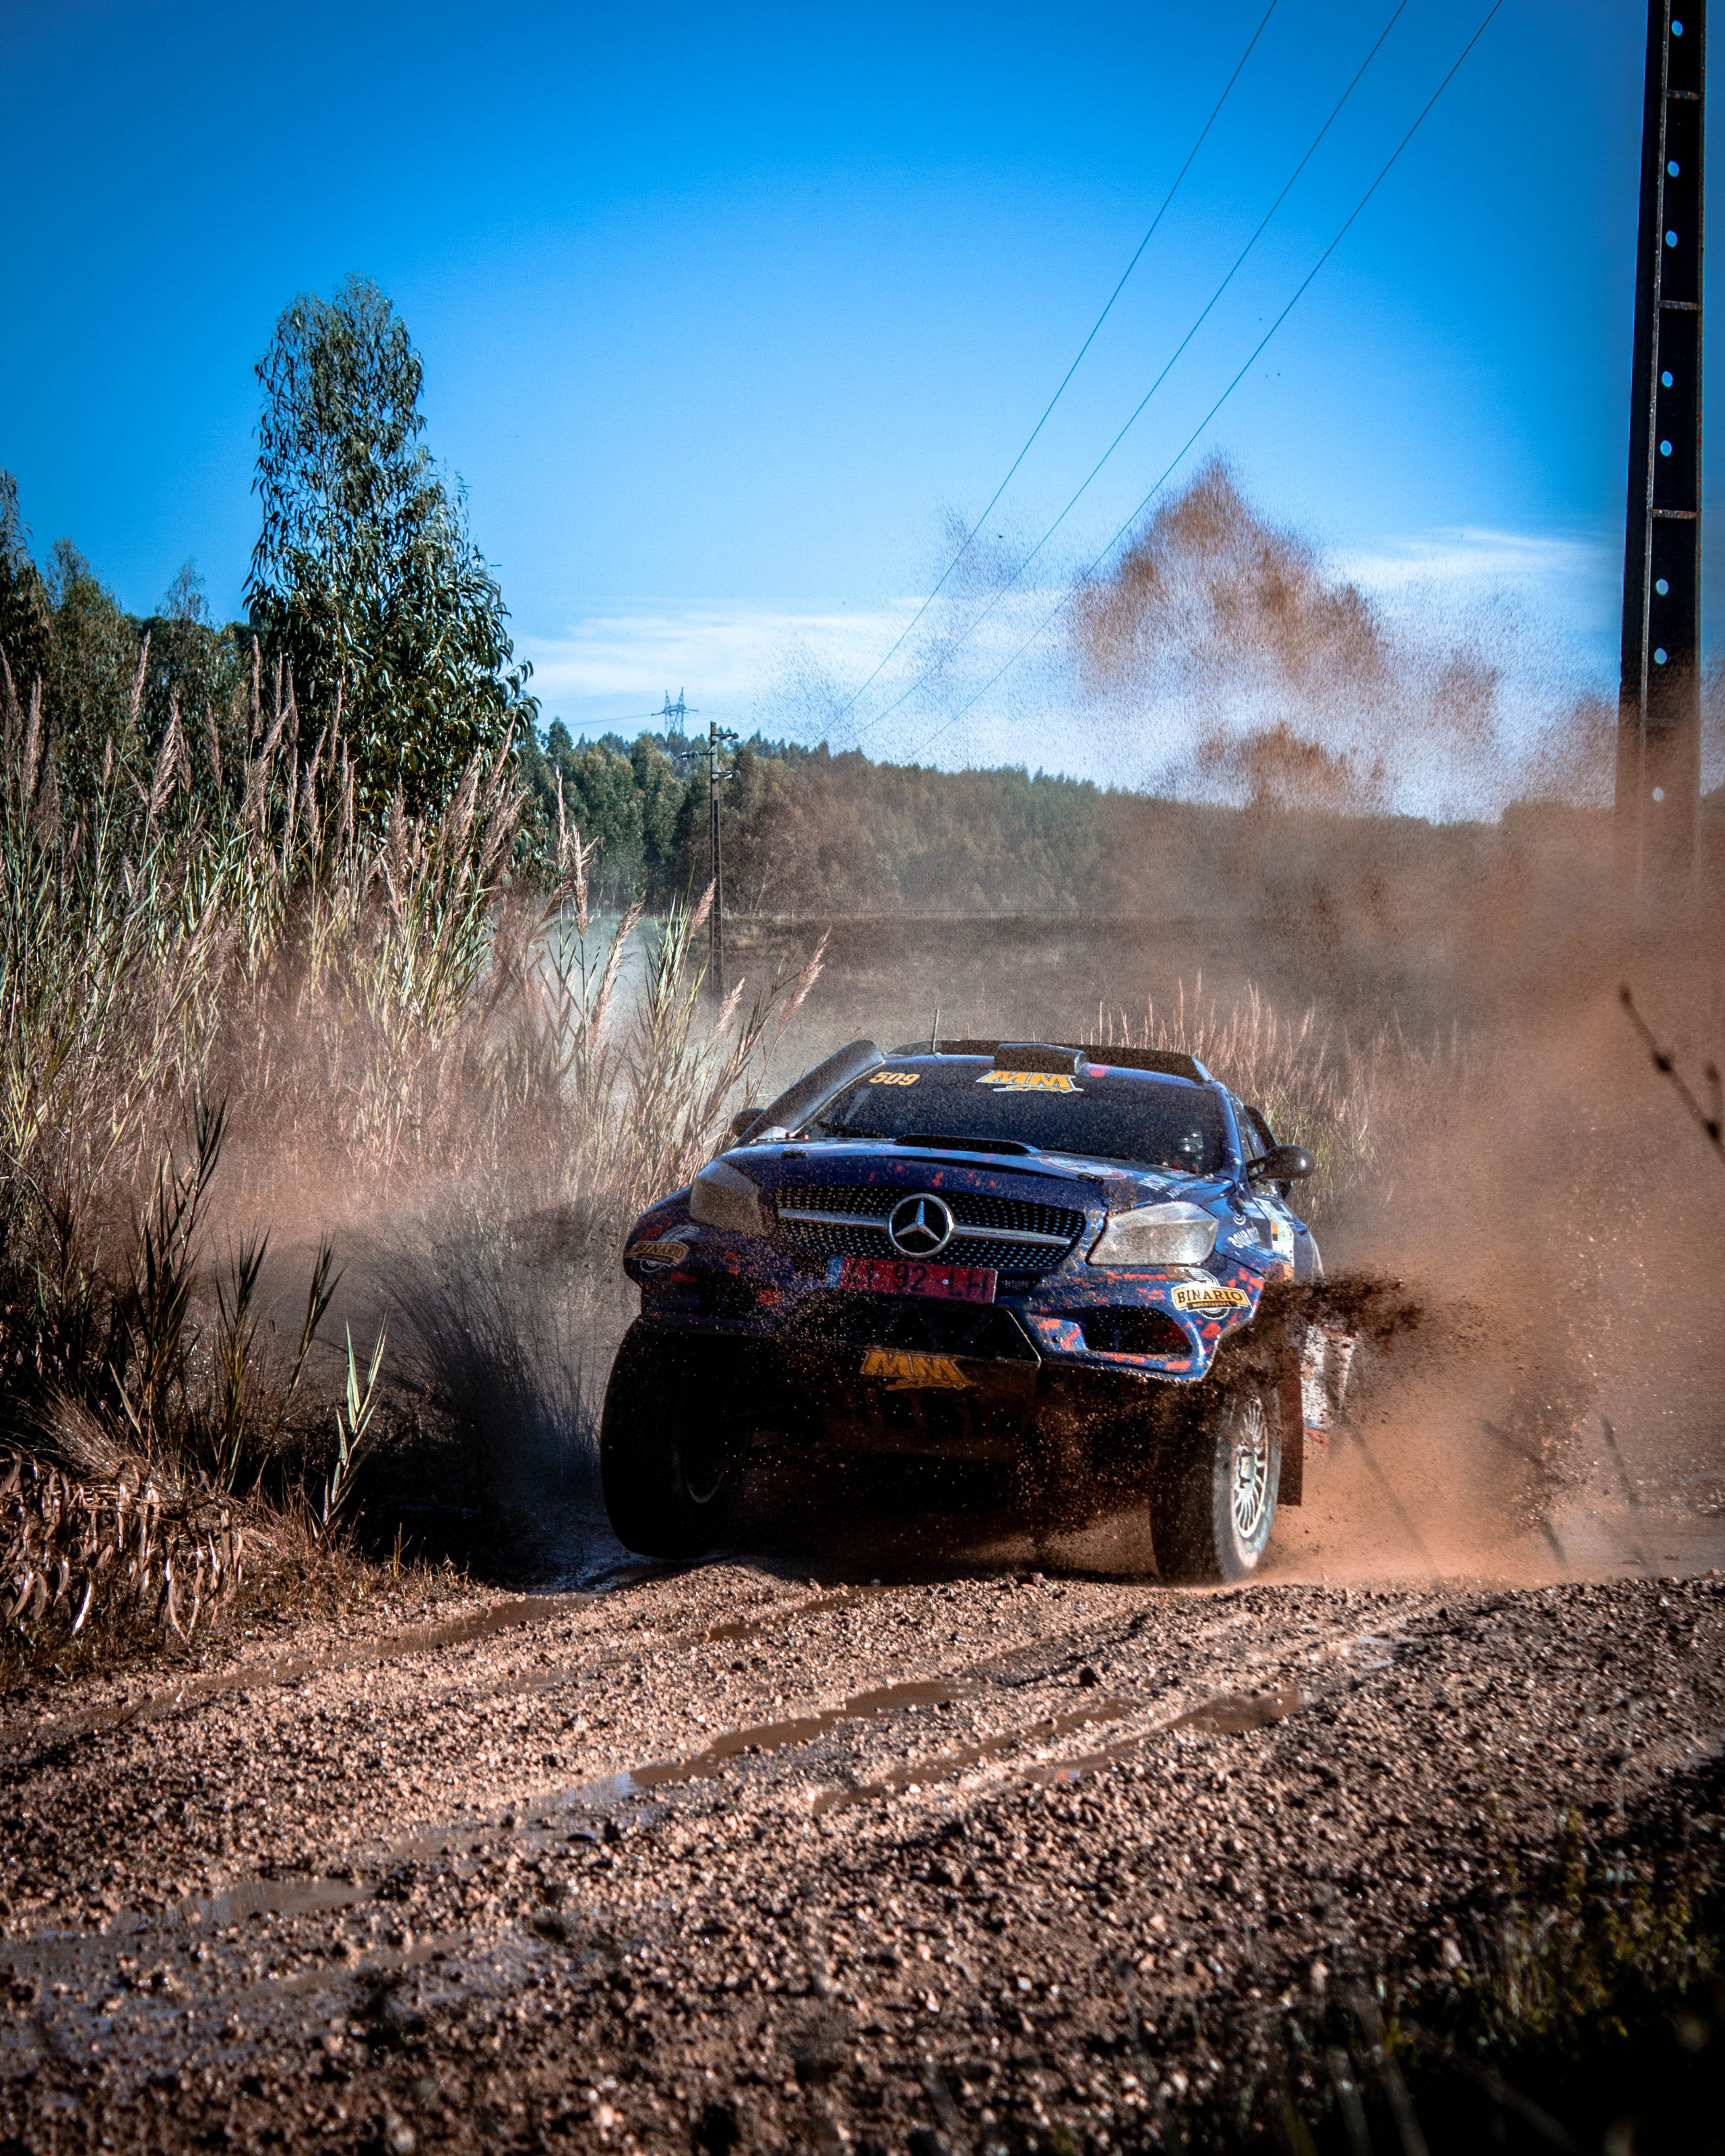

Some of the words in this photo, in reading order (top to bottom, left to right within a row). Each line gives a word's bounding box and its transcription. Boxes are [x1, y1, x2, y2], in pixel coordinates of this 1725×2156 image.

[869, 1072, 920, 1086] 509
[893, 1263, 927, 1292] 92
[947, 1269, 989, 1298] LH
[1177, 1290, 1243, 1304] BINARIO
